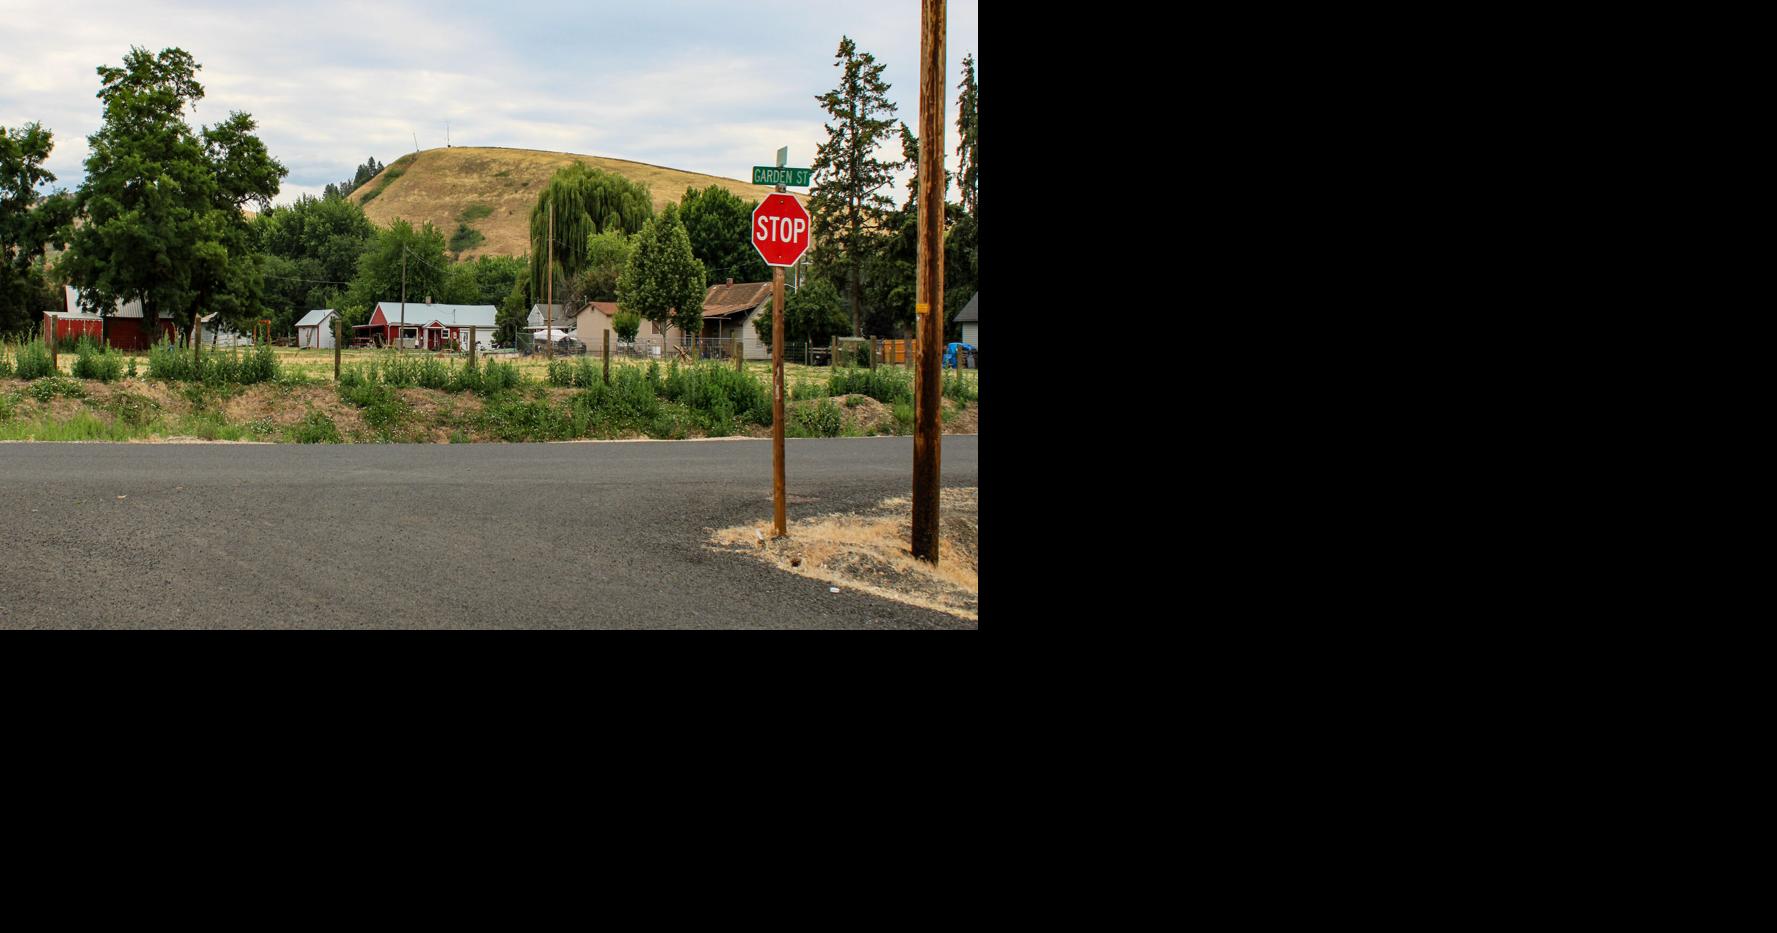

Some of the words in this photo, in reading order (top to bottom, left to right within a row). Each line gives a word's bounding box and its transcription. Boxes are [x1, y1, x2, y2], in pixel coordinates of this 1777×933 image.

[754, 168, 793, 184] GARDEN
[796, 170, 808, 184] ST
[756, 215, 806, 243] STOP
